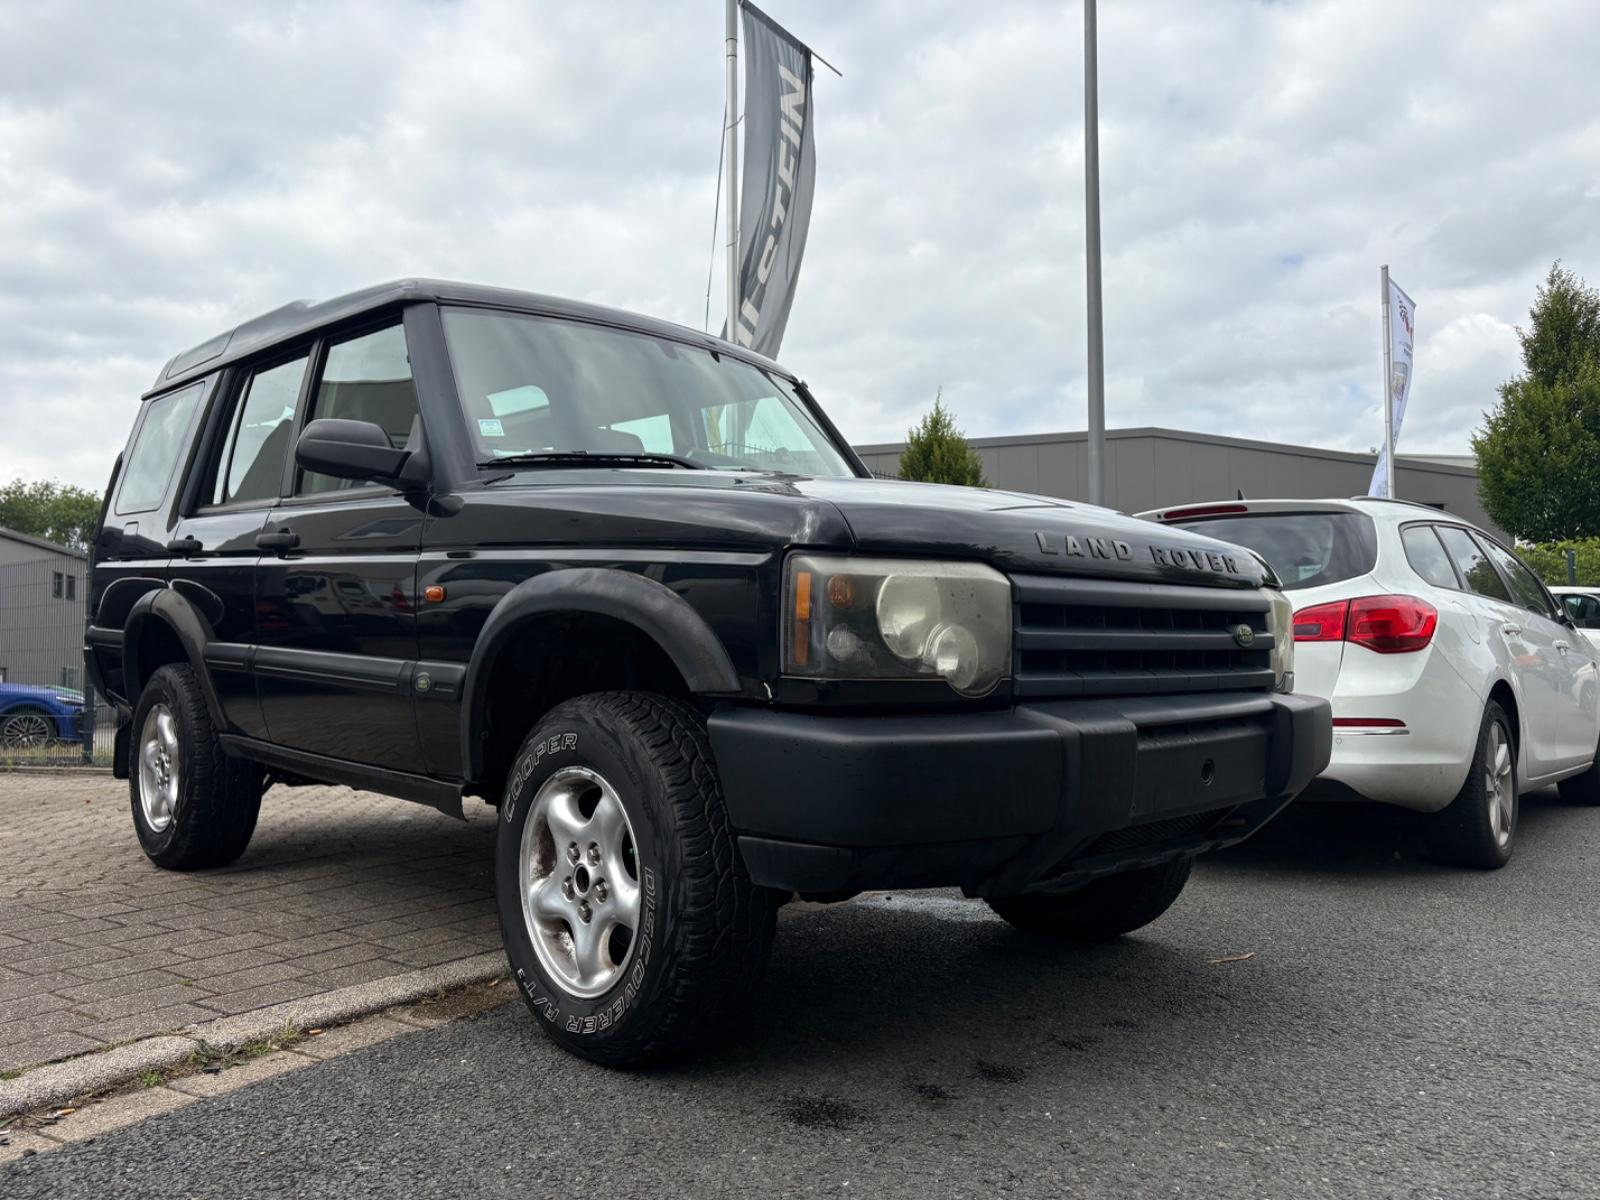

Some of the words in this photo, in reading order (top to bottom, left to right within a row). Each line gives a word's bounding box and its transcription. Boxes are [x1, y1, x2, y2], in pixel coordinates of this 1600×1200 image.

[1035, 531, 1133, 561] LAND
[1149, 545, 1240, 574] ROVER
[504, 732, 579, 824] COOPER
[565, 866, 657, 1035] DISCOVERER
